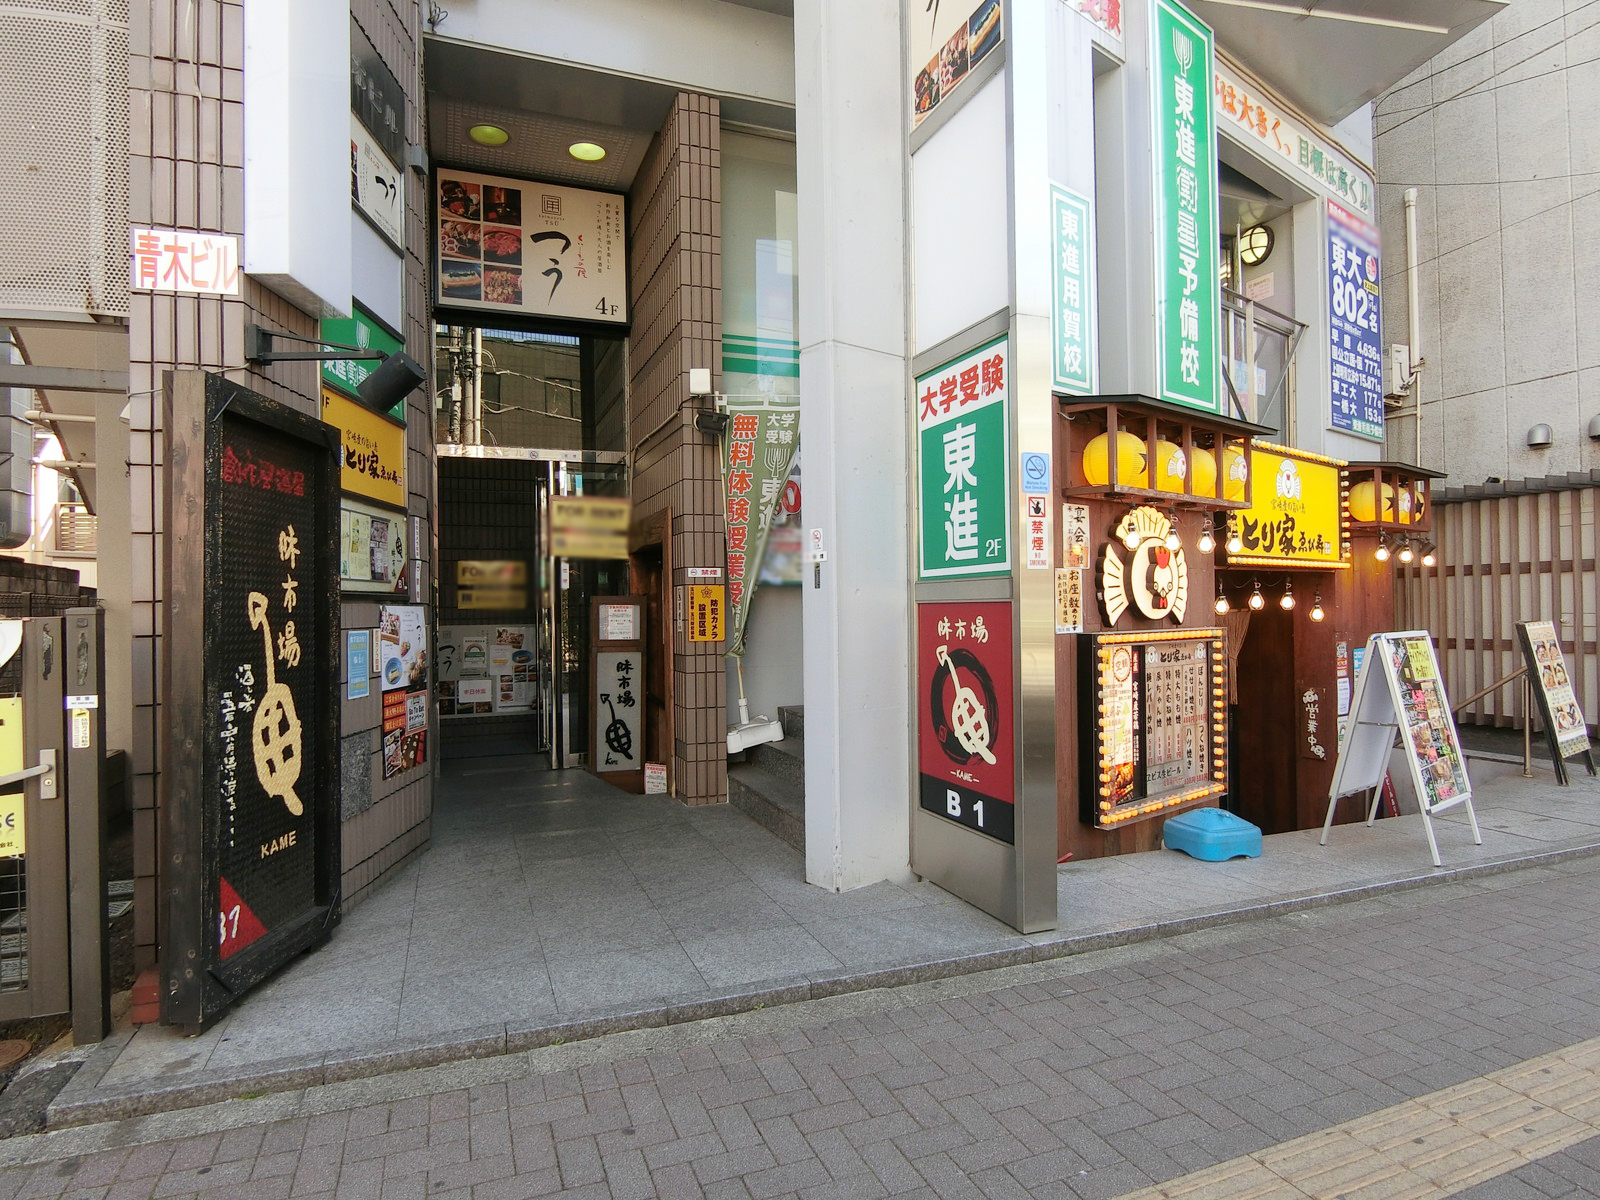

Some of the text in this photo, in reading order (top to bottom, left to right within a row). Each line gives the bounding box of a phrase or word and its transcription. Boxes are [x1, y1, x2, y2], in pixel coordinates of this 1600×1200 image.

[1174, 74, 1201, 387] 東進衛星予備校
[135, 230, 237, 291] 青木ビル
[530, 231, 572, 306] つう
[1331, 236, 1363, 287] 東大
[595, 296, 619, 316] 4F
[1061, 208, 1082, 375] 東進用賀校
[921, 353, 1005, 423] 大学受験
[1333, 379, 1357, 401] 東工大
[768, 412, 795, 428] 大学
[1333, 398, 1358, 417] 一橋大
[765, 429, 794, 445] 受験
[942, 422, 979, 562] 東進
[985, 538, 1002, 558] 2F
[1032, 520, 1044, 551] 禁煙
[1242, 512, 1298, 557] とり家
[701, 568, 719, 577] 禁煙
[277, 523, 302, 670] 味市場
[698, 603, 707, 637] 設置区域
[710, 598, 719, 640] 防犯カメラ
[937, 614, 989, 644] 味市場
[438, 644, 456, 677] つう
[616, 659, 635, 708] 味市場
[1305, 704, 1319, 746] 営業中
[261, 829, 298, 860] KAME
